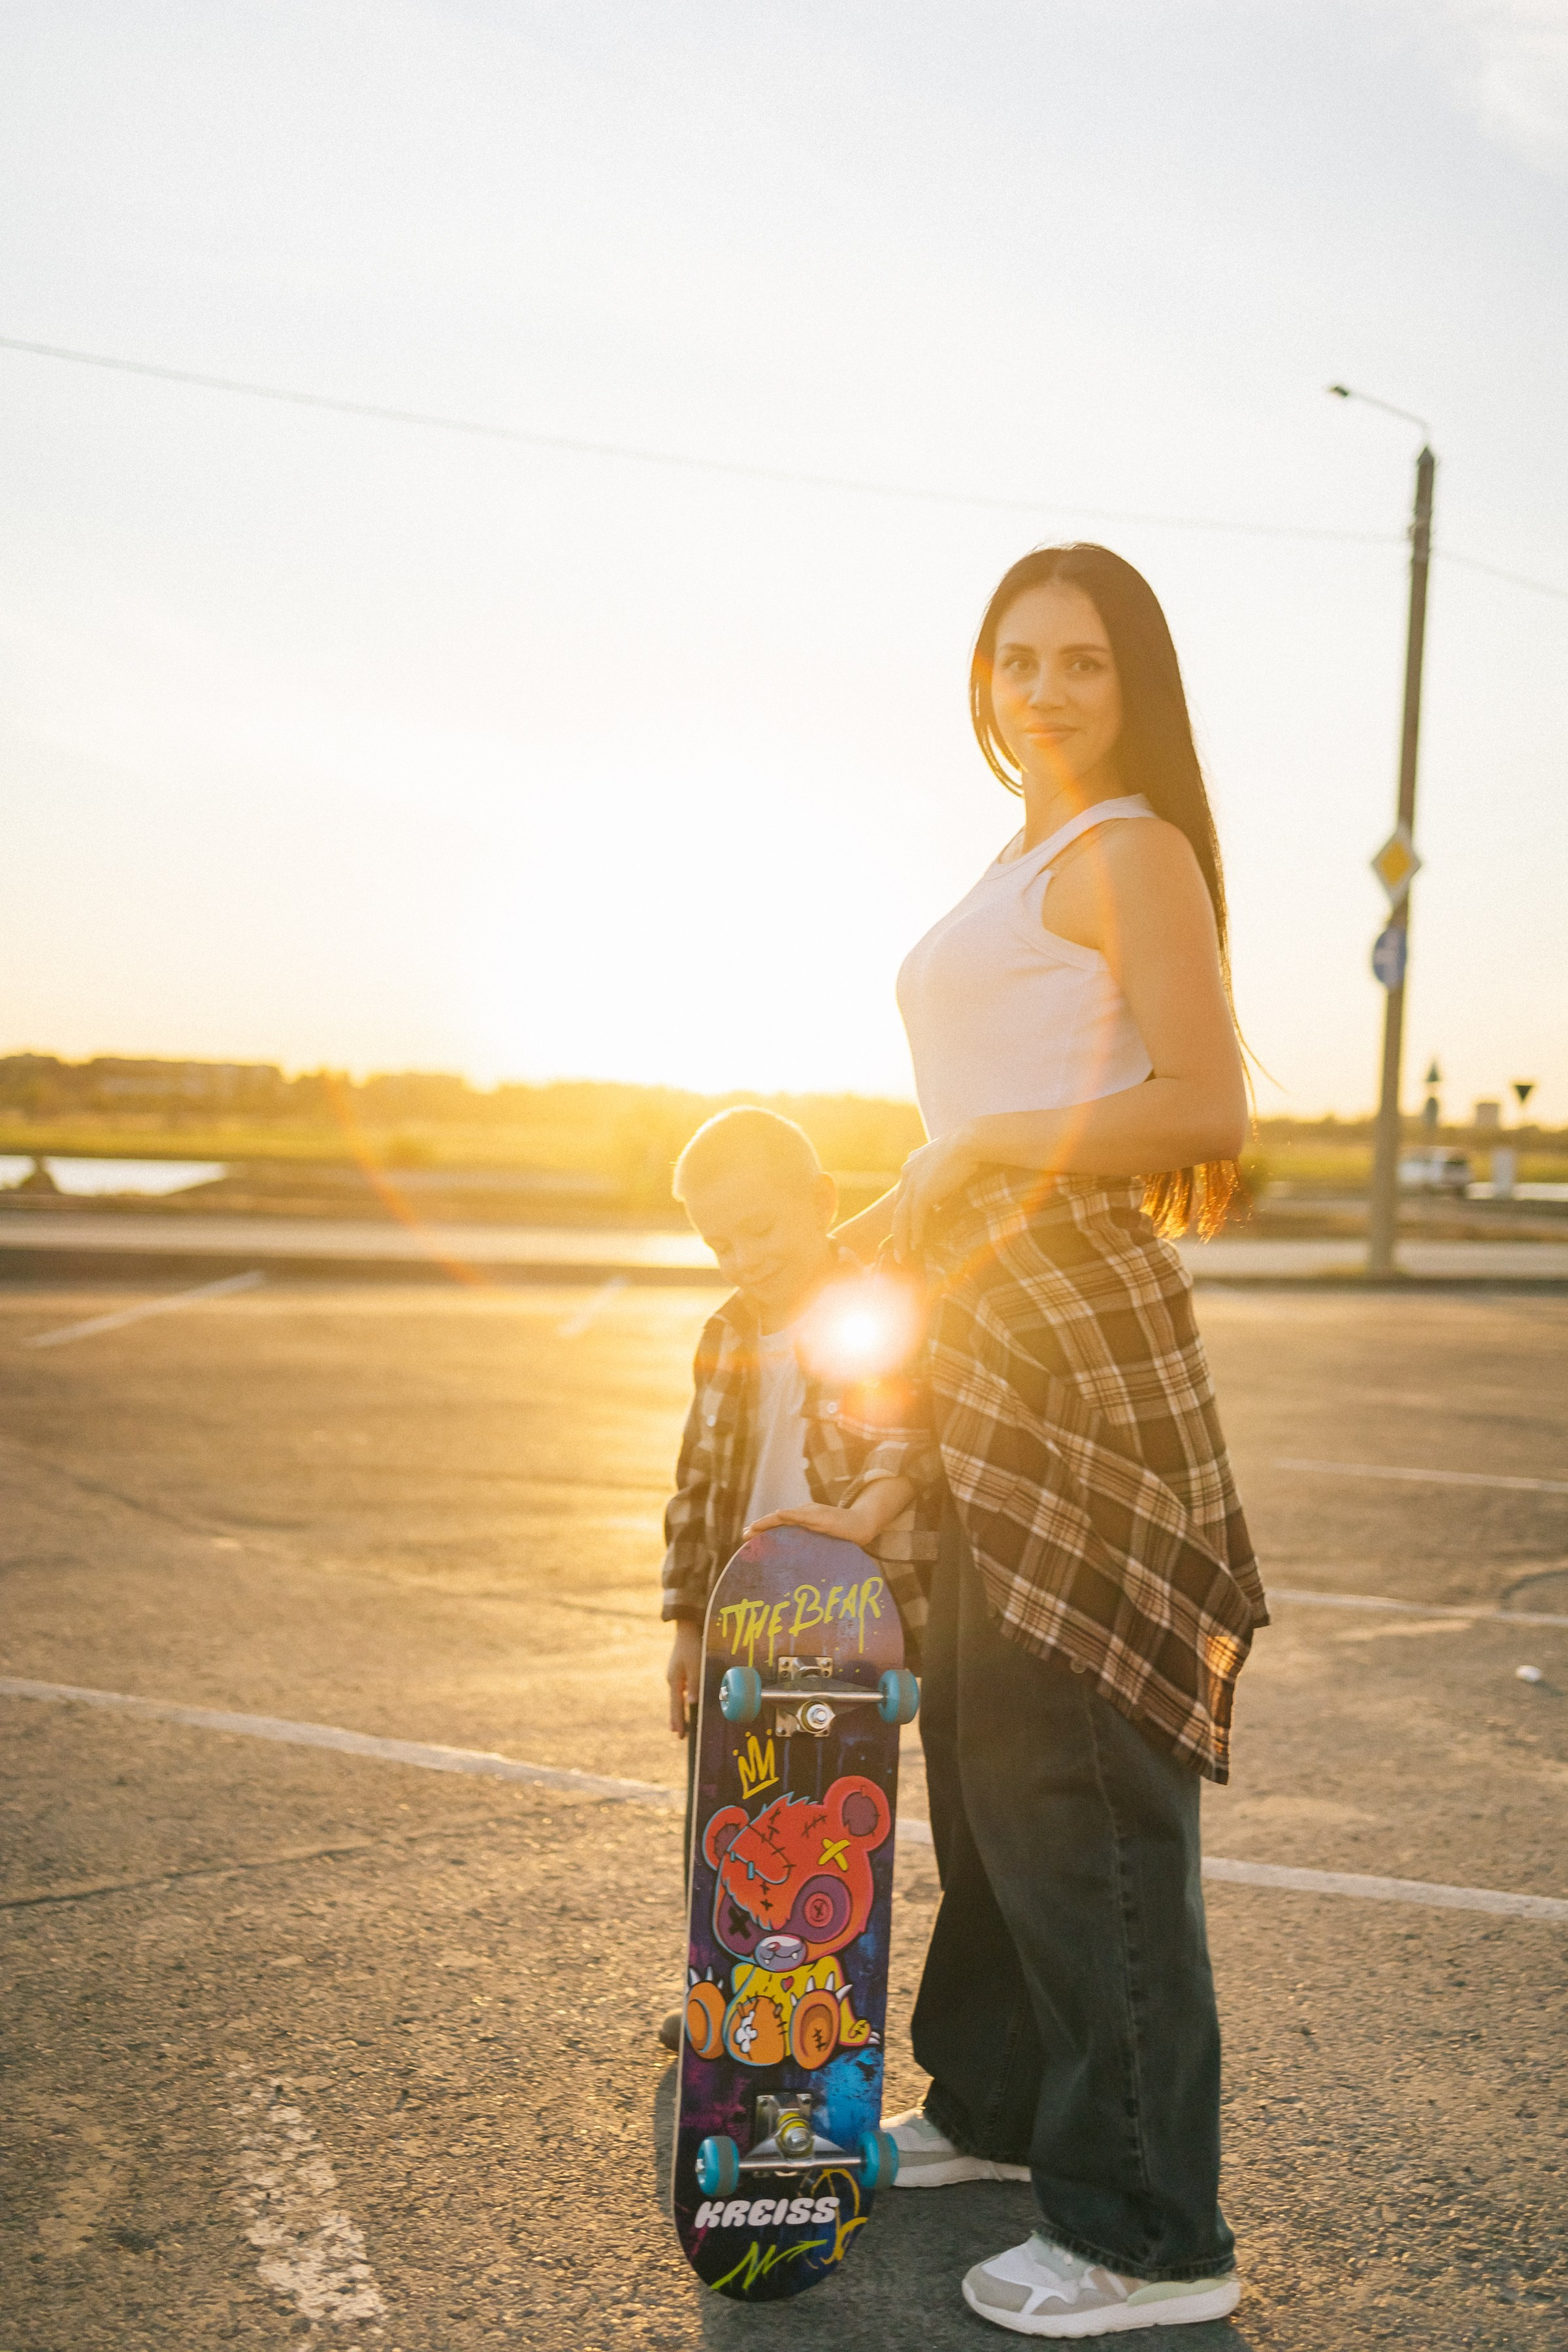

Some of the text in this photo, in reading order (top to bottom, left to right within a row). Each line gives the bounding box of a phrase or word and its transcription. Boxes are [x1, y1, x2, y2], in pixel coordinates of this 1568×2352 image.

[719, 1576, 883, 1667] THE BEAR
[694, 2197, 840, 2229] KREISS
